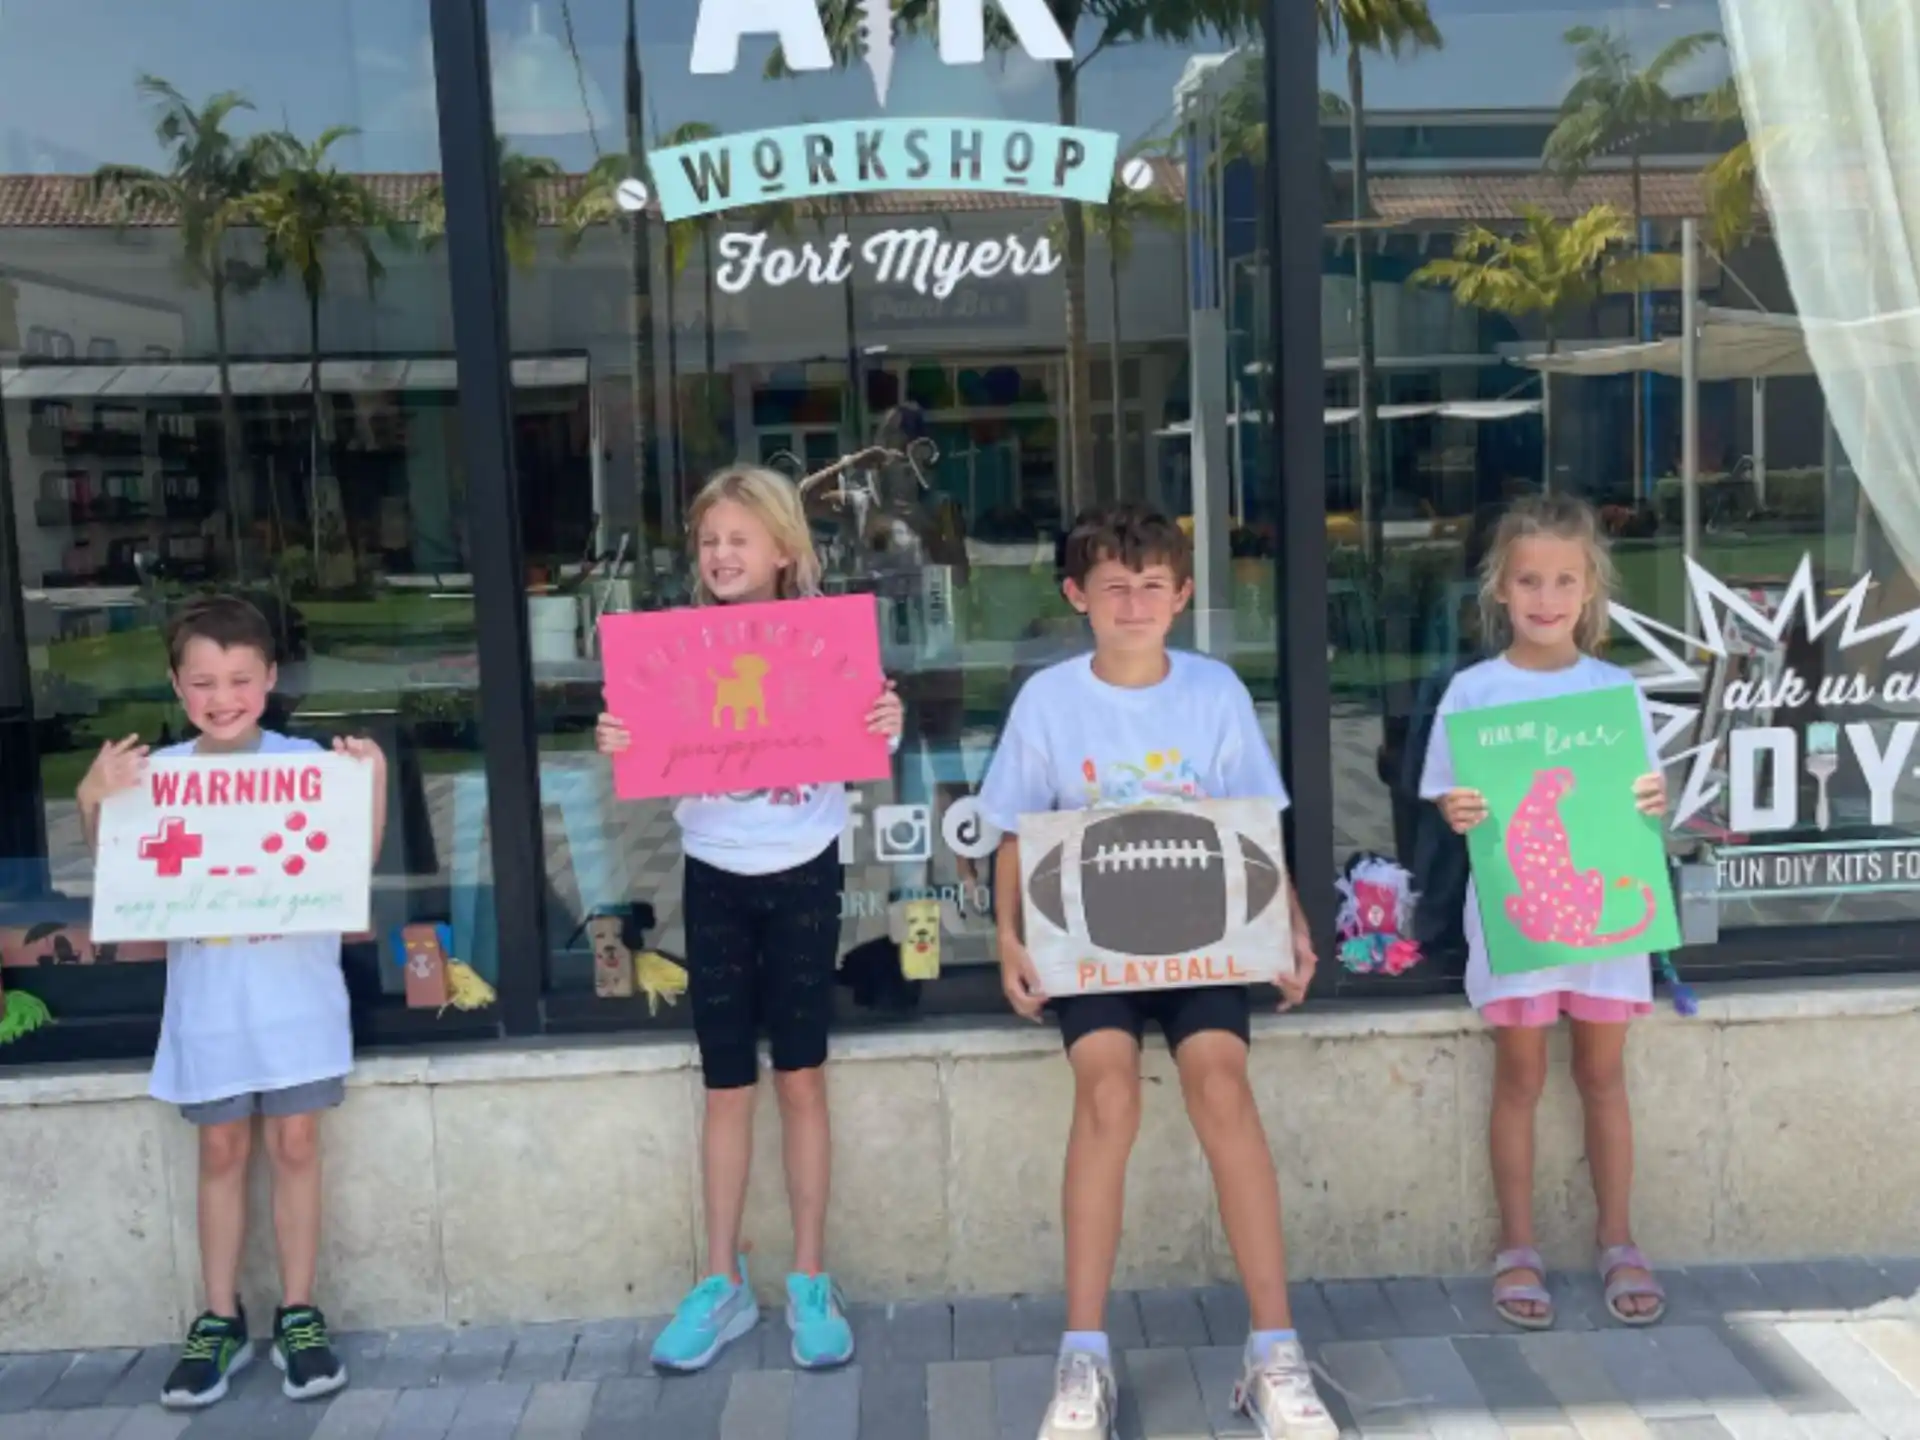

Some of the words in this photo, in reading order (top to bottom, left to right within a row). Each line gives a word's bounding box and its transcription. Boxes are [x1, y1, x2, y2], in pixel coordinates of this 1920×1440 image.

[679, 129, 1086, 204] WORKSHOP
[716, 230, 853, 294] Fort
[862, 227, 1063, 300] Myers
[1722, 667, 1811, 711] ask
[1815, 672, 1874, 706] us
[151, 765, 323, 807] WARNING
[1716, 859, 1765, 888] FUN
[1775, 856, 1819, 886] DIY
[1826, 853, 1882, 884] KITS
[1077, 955, 1247, 989] PLAYBALL
